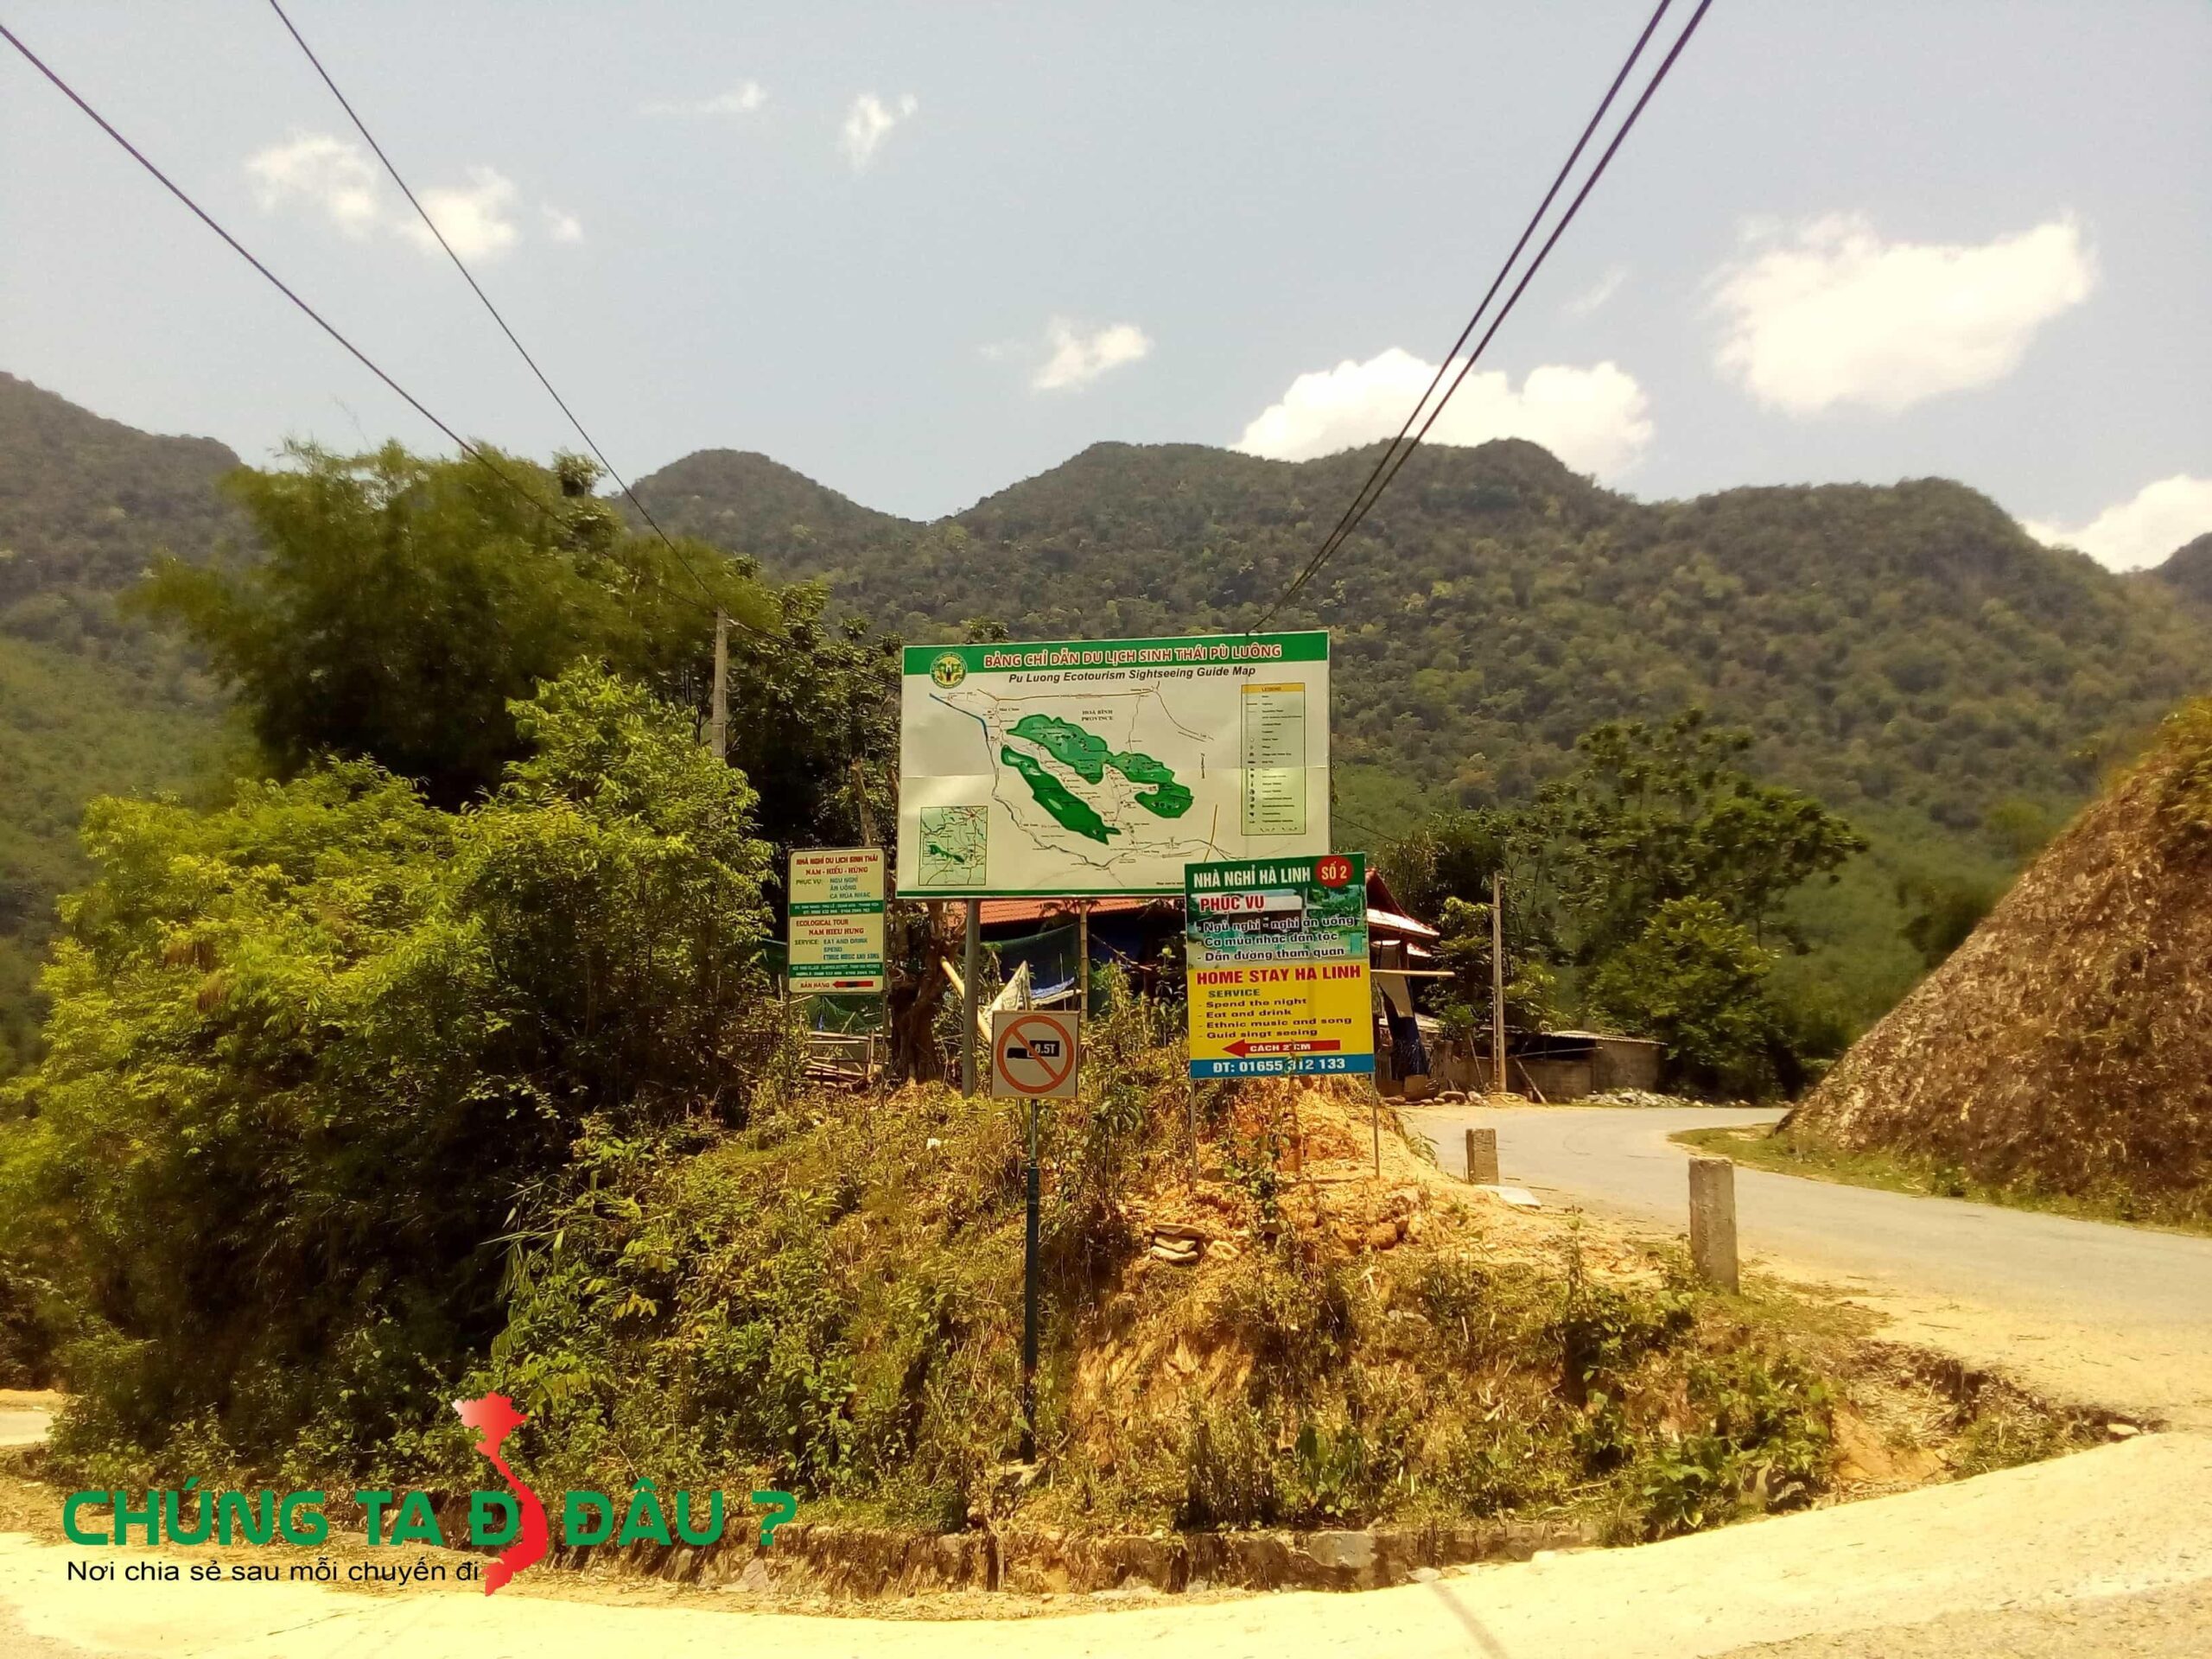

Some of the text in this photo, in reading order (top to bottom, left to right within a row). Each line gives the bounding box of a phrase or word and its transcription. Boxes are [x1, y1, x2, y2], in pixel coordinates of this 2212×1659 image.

[984, 642, 1282, 667] BẢNG CHỈ DẪN DU LỊCH SINH THÁI PÙ LUÔNG
[1008, 666, 1256, 683] Pu Luong Ecotourism Sightseeing Guide Map
[1193, 864, 1311, 888] NHÀ NGHỈ HÀ LINH
[1321, 861, 1347, 880] SỐ 2
[1200, 895, 1265, 913] PHỤC VỤ
[1204, 919, 1230, 933] Ngủ
[1205, 938, 1222, 947] Ca
[1318, 931, 1338, 944] tộc
[1276, 949, 1310, 959] tham
[1313, 948, 1344, 959] quan
[1197, 965, 1361, 985] HOME STAY HA LINH
[1208, 988, 1261, 998] SERVICE
[1206, 1000, 1246, 1009] Spend
[1274, 998, 1307, 1007] night
[1259, 1008, 1292, 1017] drink
[1206, 1020, 1247, 1029] Ethnic
[1241, 1030, 1272, 1039] singt
[1276, 1029, 1319, 1039] seeing
[1034, 1043, 1056, 1054] 0.5T
[1213, 1062, 1235, 1073] ĐT:
[1239, 1059, 1283, 1072] 01655
[1319, 1058, 1345, 1070] 133
